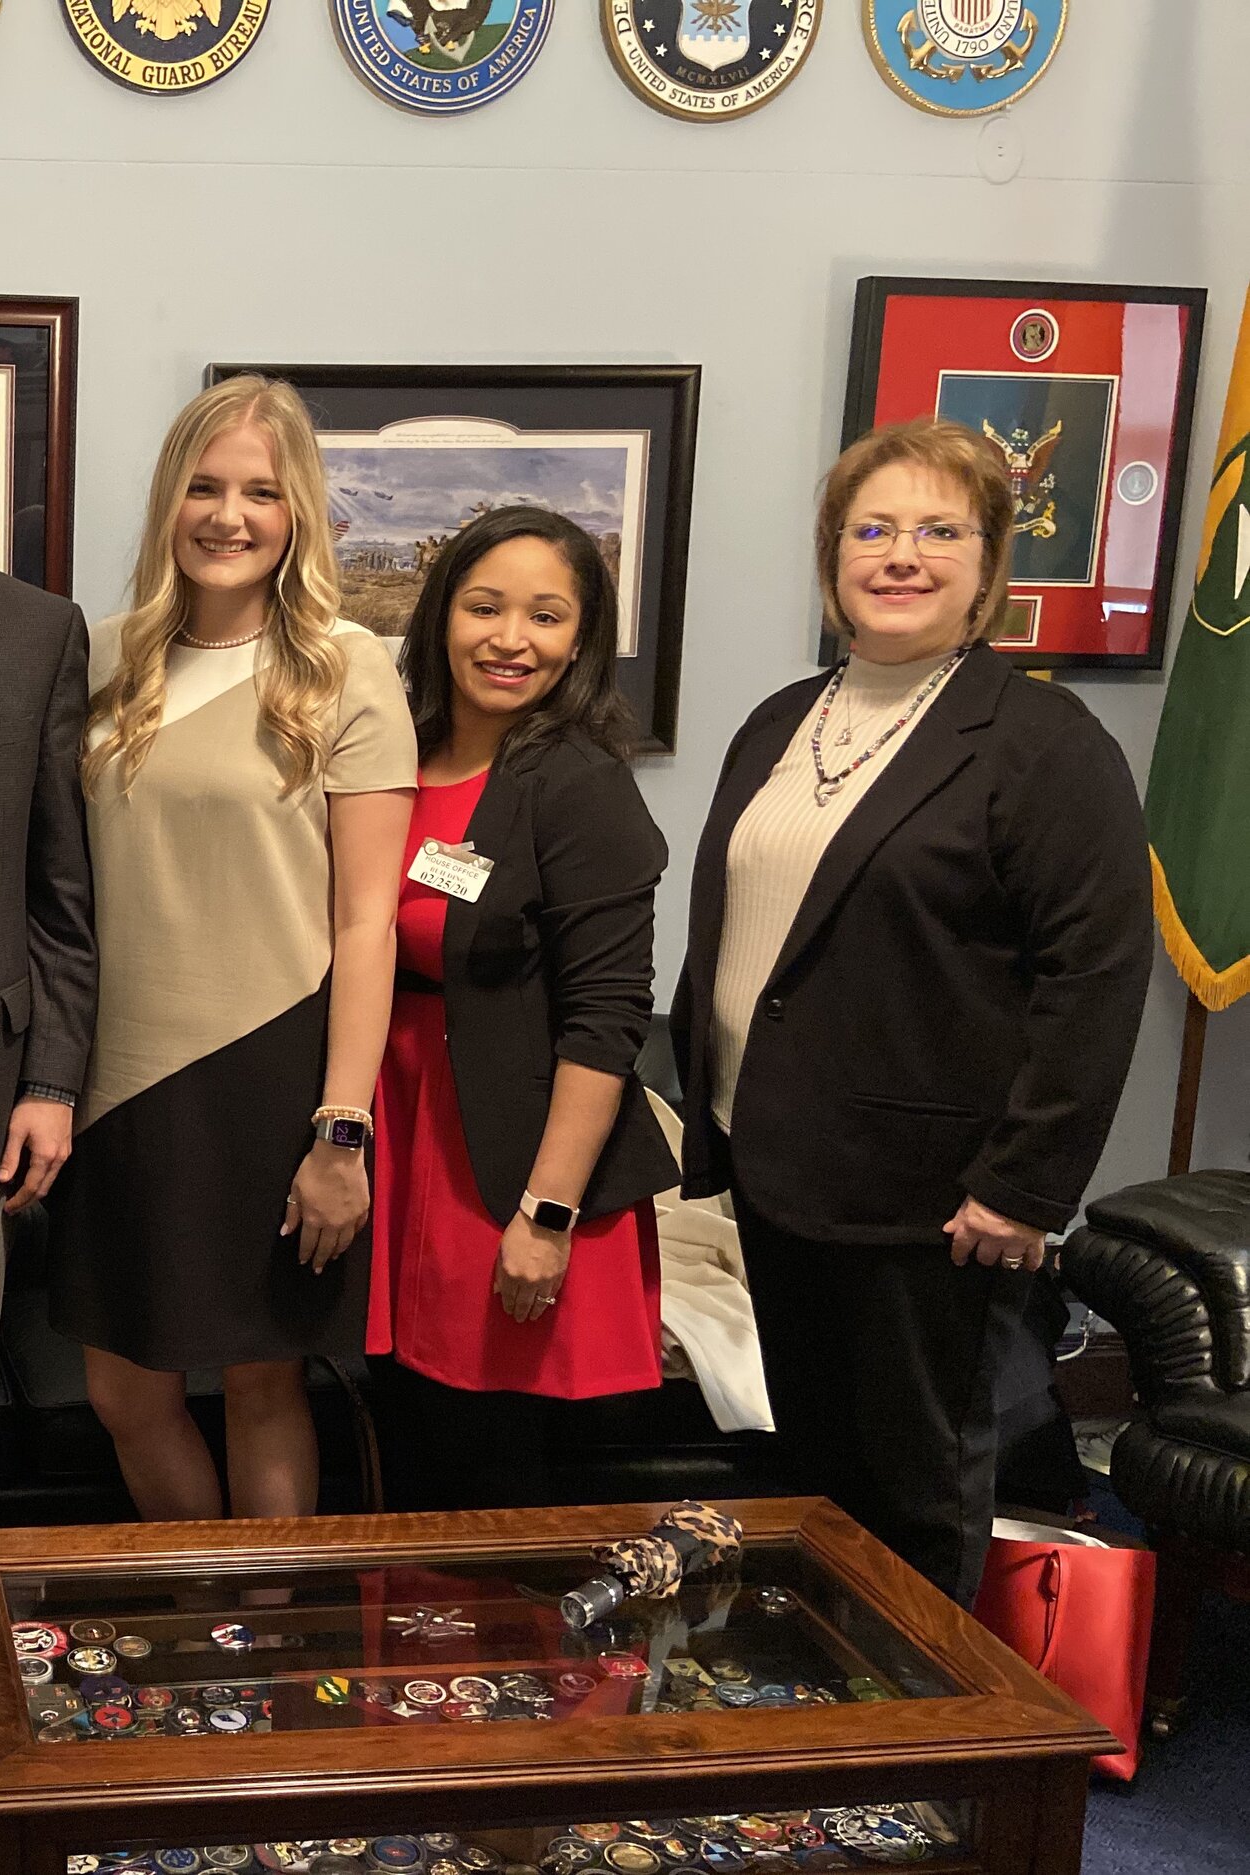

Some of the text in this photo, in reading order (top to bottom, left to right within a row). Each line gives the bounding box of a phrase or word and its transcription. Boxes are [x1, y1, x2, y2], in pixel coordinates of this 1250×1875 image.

[953, 22, 991, 34] PARATUS
[69, 0, 263, 86] NATIONAL GUARD BUREAU
[353, 0, 537, 93] UNITED STATES OF AMERICA
[954, 39, 989, 54] 1790
[628, 47, 795, 109] UNITED STATES OF AMERICA
[674, 65, 752, 86] MCMXLVII
[425, 855, 451, 869] HOUSE
[451, 865, 480, 880] OFFICE
[419, 871, 468, 896] 02/25/20
